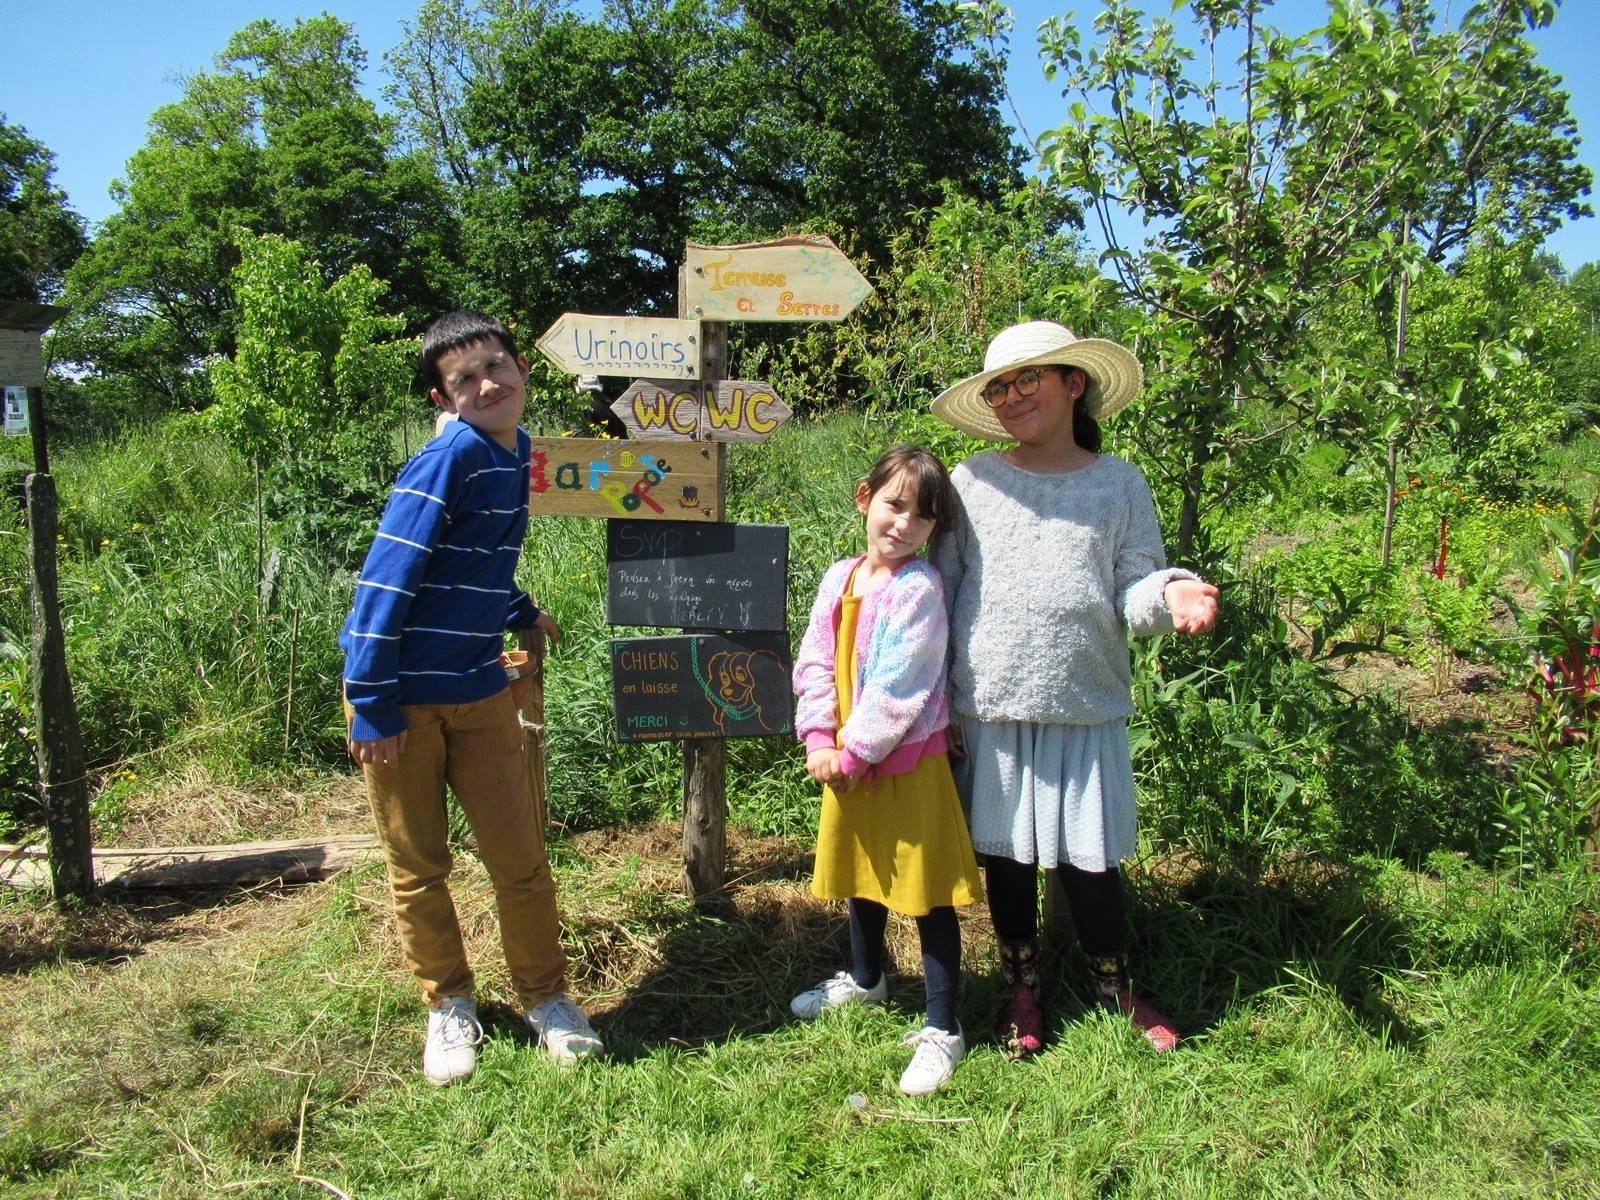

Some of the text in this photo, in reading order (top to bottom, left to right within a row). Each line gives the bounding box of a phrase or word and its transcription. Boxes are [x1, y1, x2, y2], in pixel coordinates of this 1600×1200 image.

[776, 291, 840, 316] Serres
[574, 329, 685, 364] Urinoirs
[631, 391, 698, 434] WC
[705, 387, 778, 434] WC
[621, 651, 679, 672] CHIENS
[622, 680, 679, 694] en laisse
[627, 715, 668, 729] MERCI
